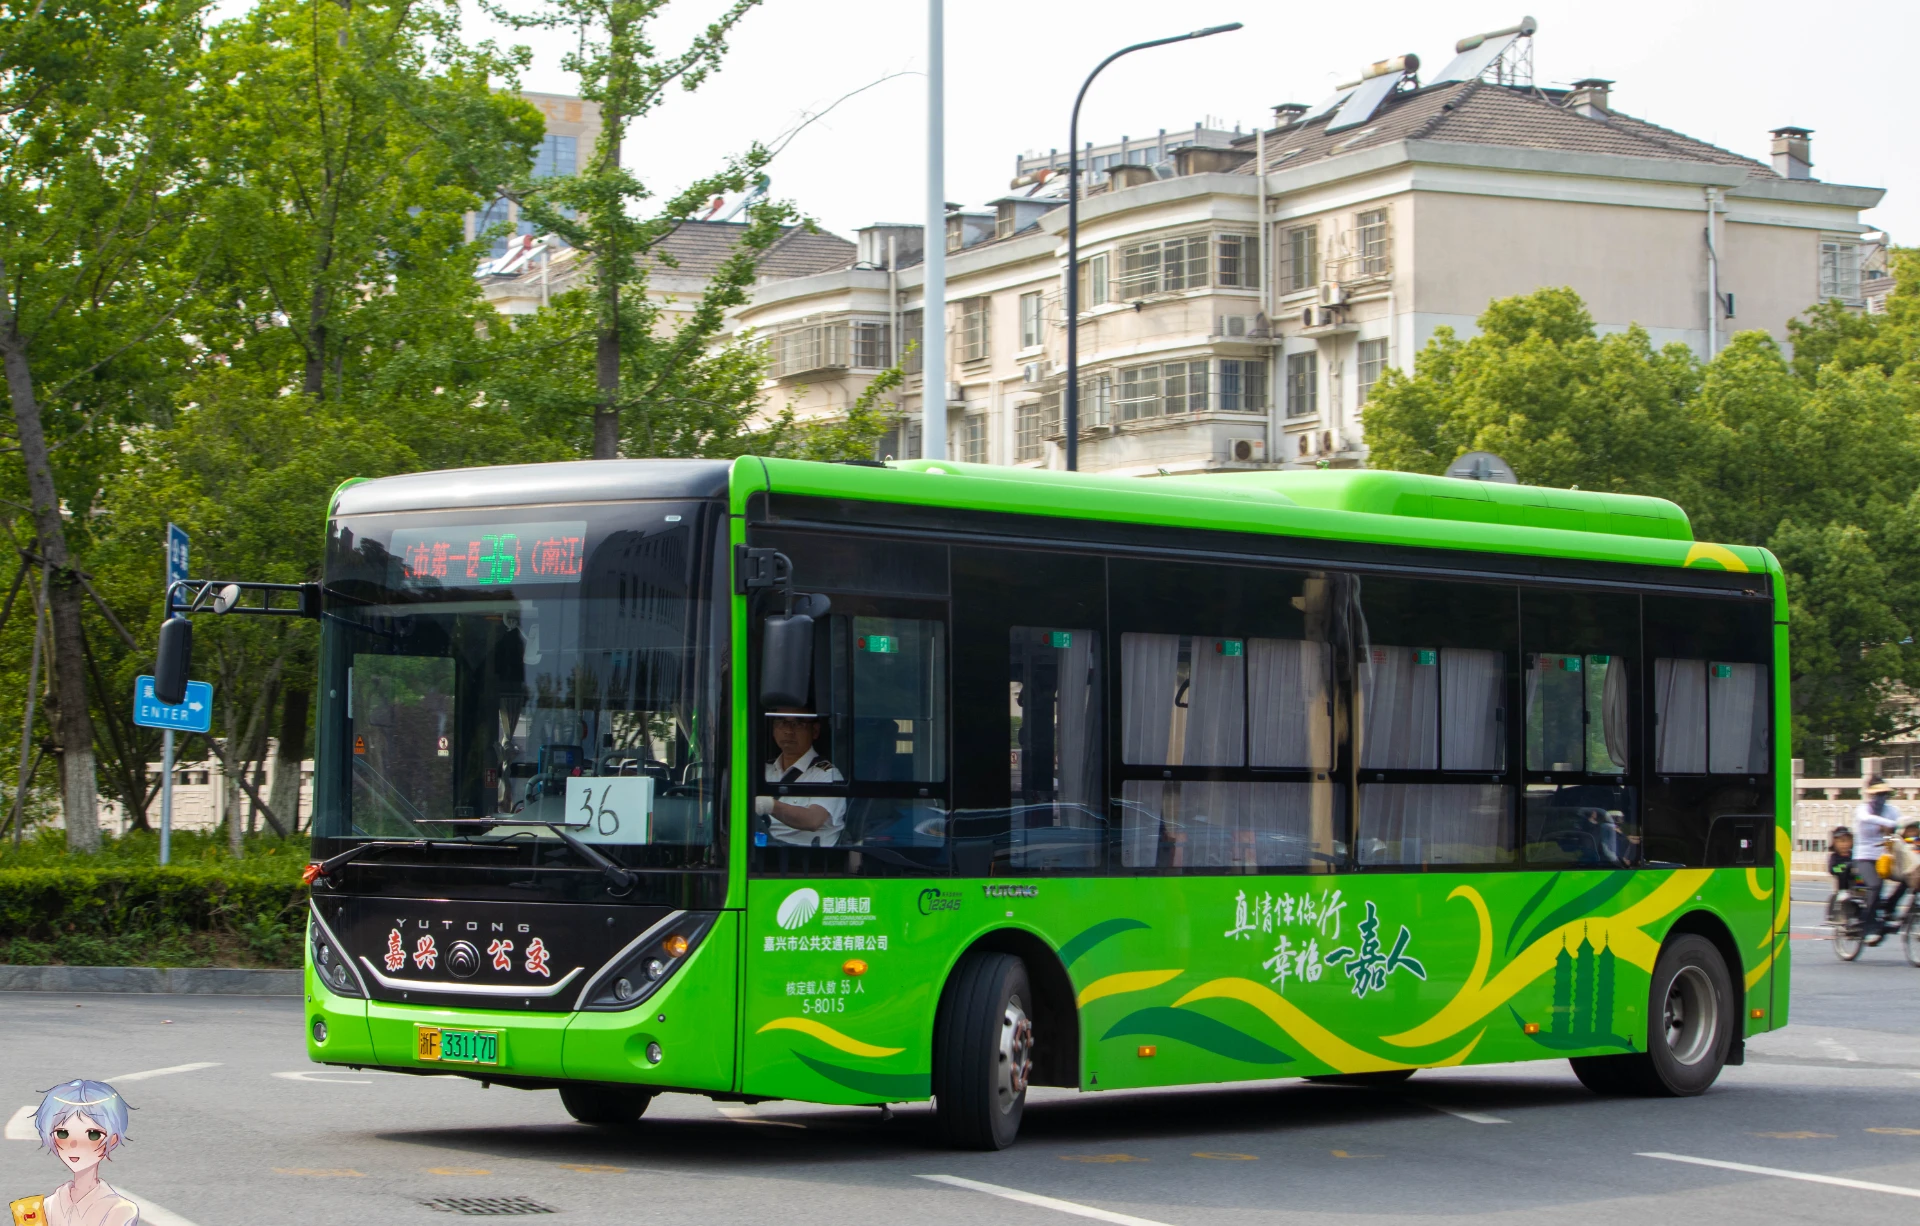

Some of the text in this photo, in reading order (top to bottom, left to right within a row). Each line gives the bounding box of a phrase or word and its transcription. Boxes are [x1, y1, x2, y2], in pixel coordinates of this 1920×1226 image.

[141, 705, 188, 721] ENTER
[575, 784, 620, 836] 36
[982, 884, 1039, 898] YUTONG
[822, 896, 871, 914] 嘉通集团
[928, 898, 962, 911] 12345
[1224, 888, 1348, 941] 真情伴你行
[396, 918, 530, 933] YUTONG
[763, 935, 888, 952] 嘉兴市公共交通有限公司
[786, 979, 865, 996] 核定载人数 55 人
[802, 998, 845, 1014] 5-8015
